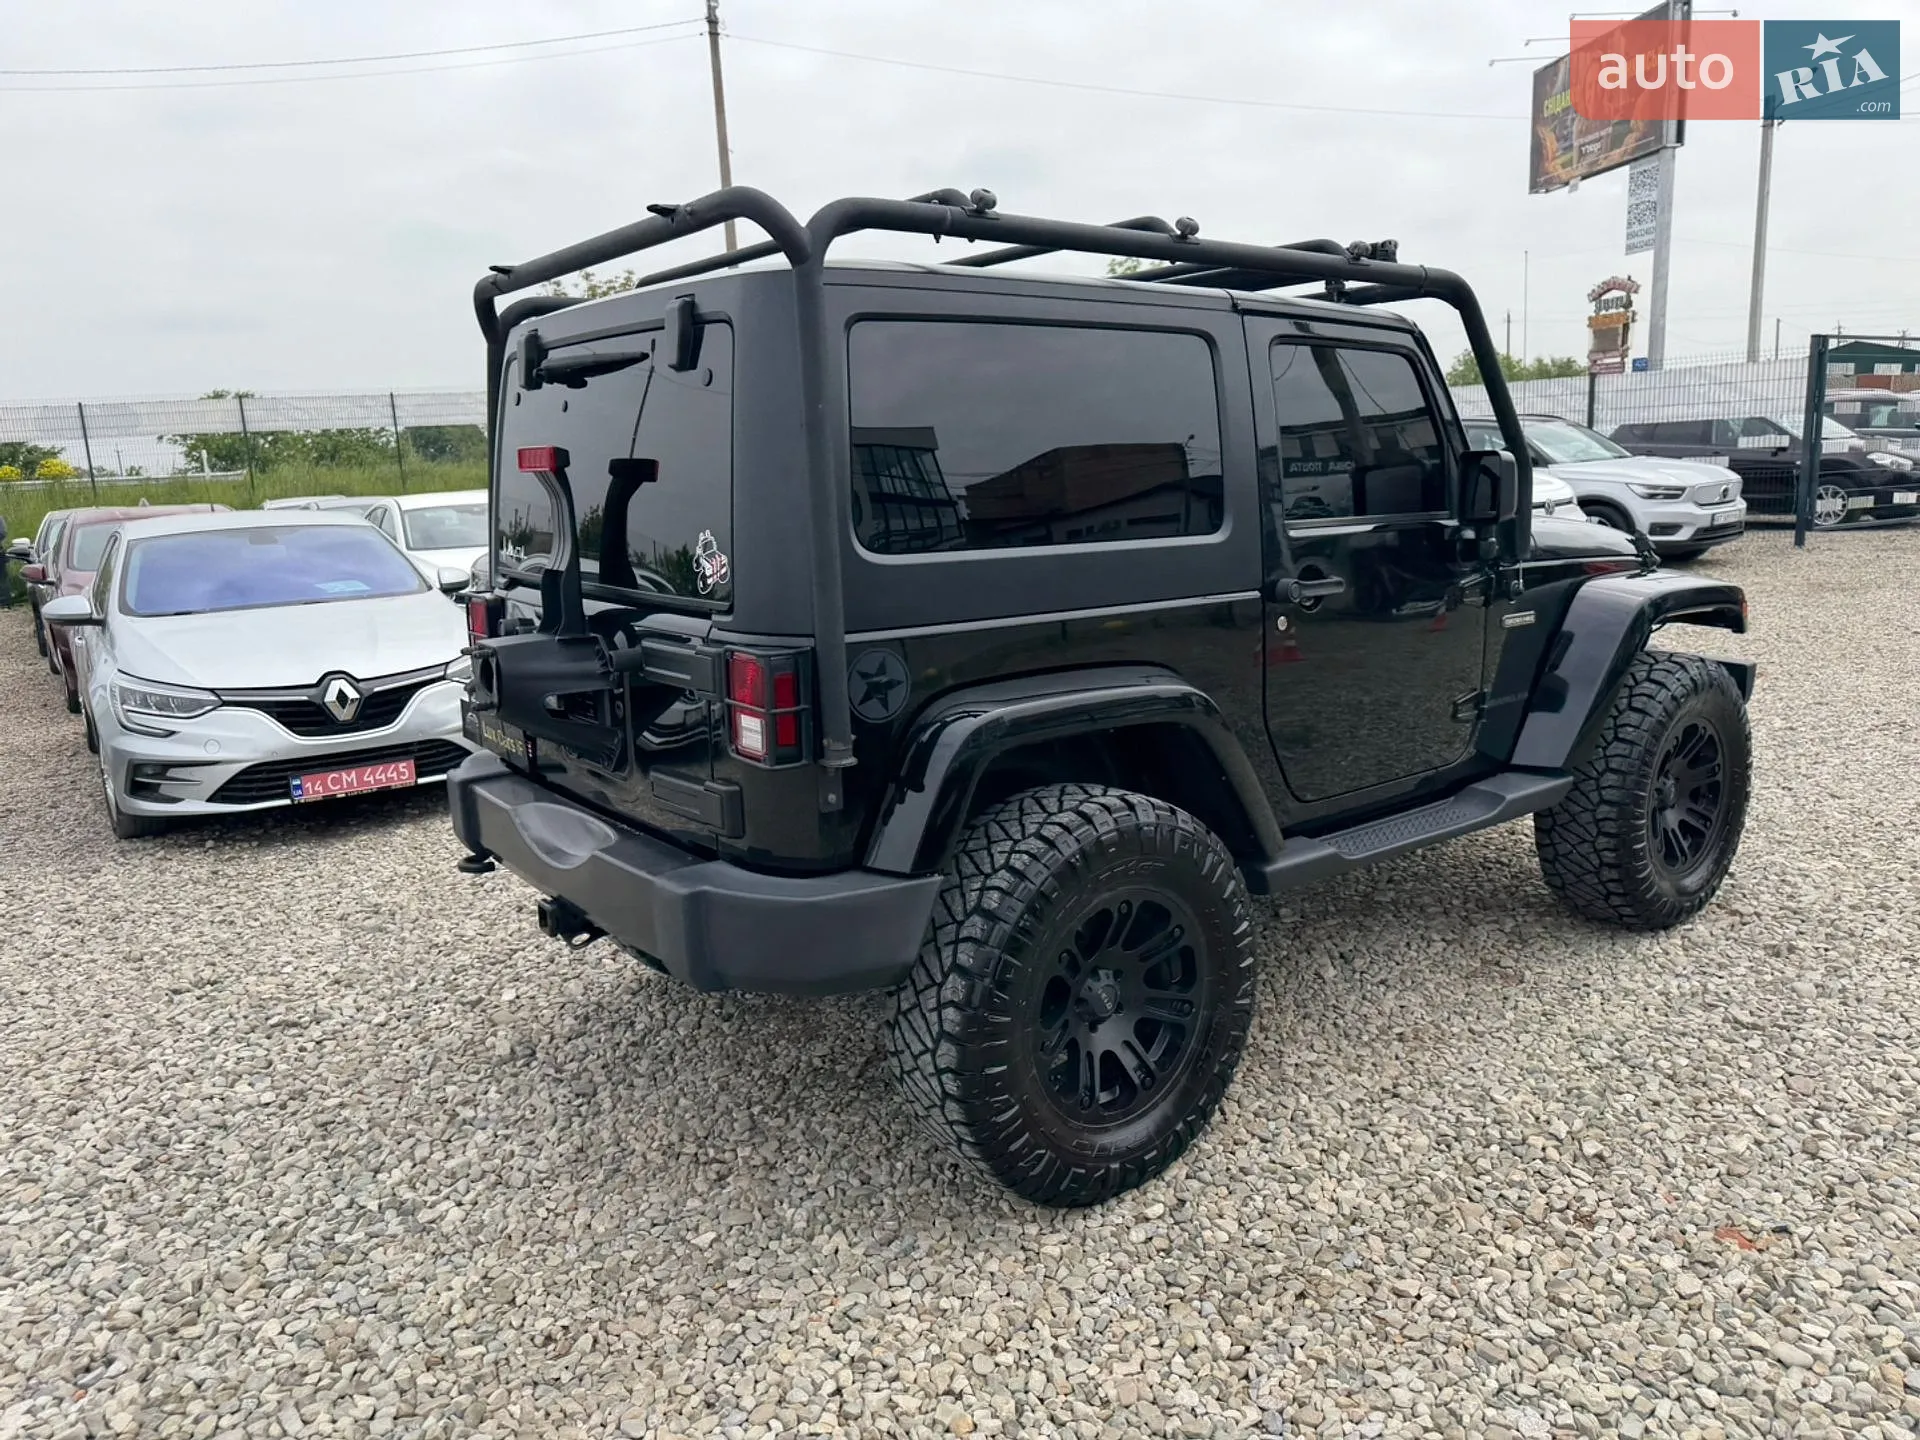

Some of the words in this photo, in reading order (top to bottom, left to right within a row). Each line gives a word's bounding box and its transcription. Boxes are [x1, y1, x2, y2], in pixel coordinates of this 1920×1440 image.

[305, 781, 323, 794] 14
[327, 771, 357, 790] CM
[363, 763, 409, 785] 4445
